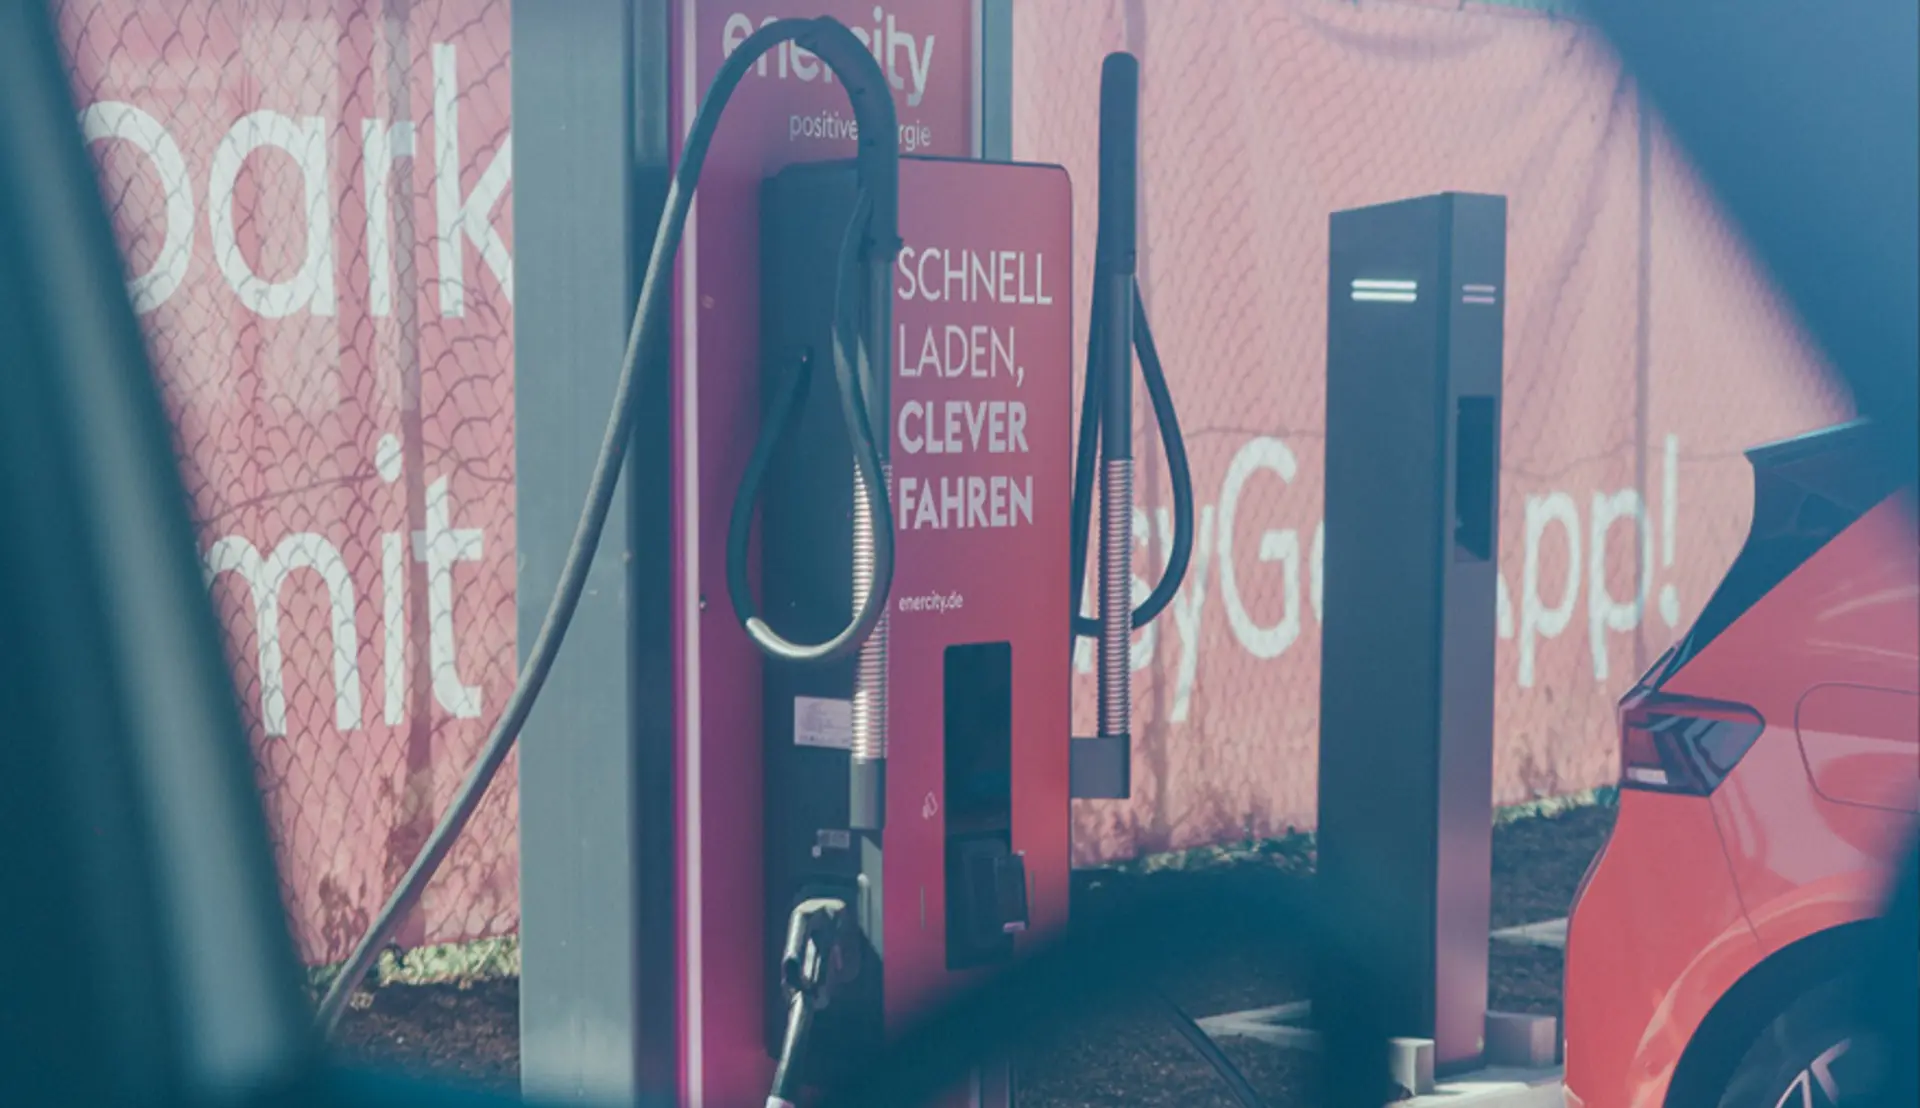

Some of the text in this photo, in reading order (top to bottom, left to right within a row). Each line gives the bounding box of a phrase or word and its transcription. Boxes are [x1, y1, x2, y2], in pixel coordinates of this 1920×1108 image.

[789, 110, 859, 142] positive
[898, 246, 1053, 305] SCHNELL
[899, 323, 1024, 388] LADEN,
[898, 400, 1029, 454] CLEVER
[899, 475, 1034, 530] FAHREN
[1496, 432, 1680, 688] pp!
[898, 590, 964, 614] enercity.de
